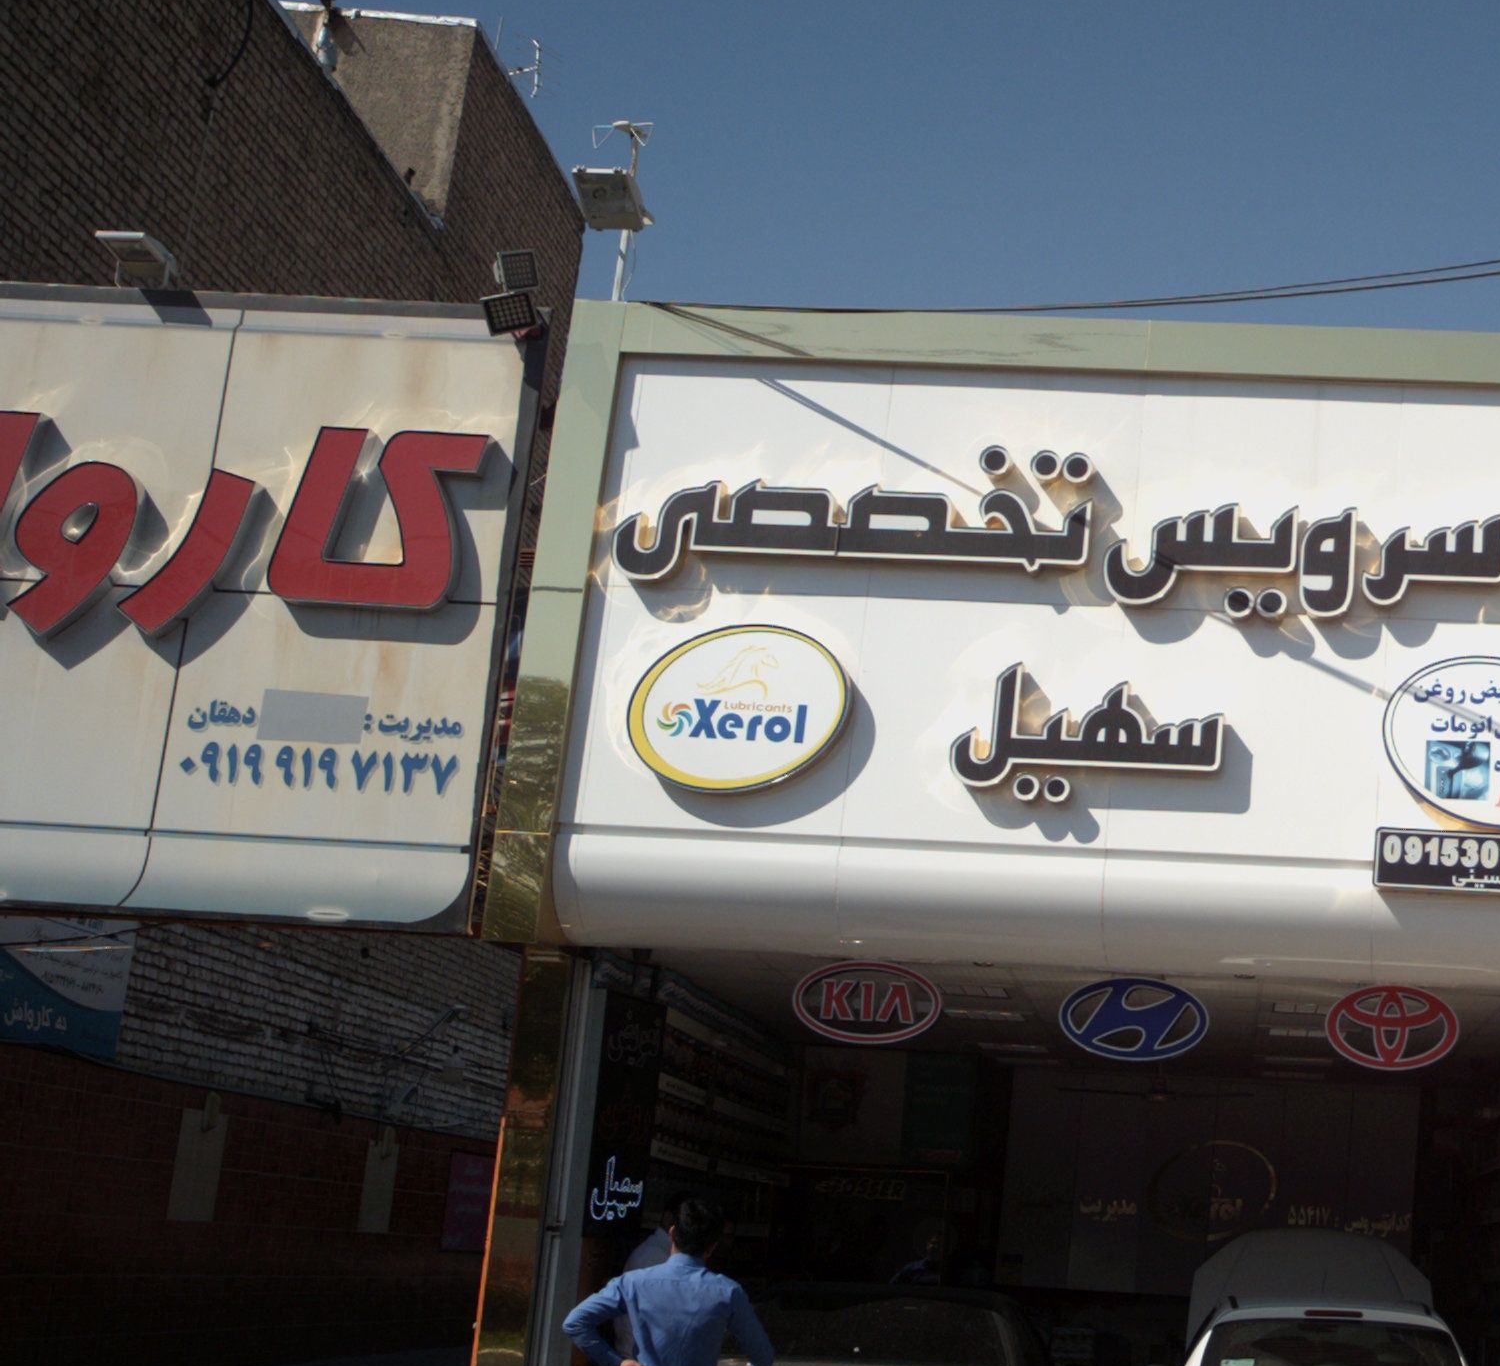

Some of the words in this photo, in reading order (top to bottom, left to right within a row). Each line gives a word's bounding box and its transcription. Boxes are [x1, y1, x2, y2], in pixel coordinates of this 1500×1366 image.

[0, 411, 491, 635] کارو
[610, 445, 1094, 581] تخصصی
[187, 698, 257, 730] دهقان
[723, 700, 793, 714] Lubricants
[1413, 678, 1466, 705] روغن
[688, 698, 808, 744] Xerol
[949, 662, 1225, 804] سهیل
[1430, 714, 1494, 739] اتومات
[274, 745, 338, 790] ۹۱۹
[351, 749, 458, 796] ۷۱۳۷
[819, 979, 916, 1025] KIA
[590, 1154, 644, 1221] سهیل
